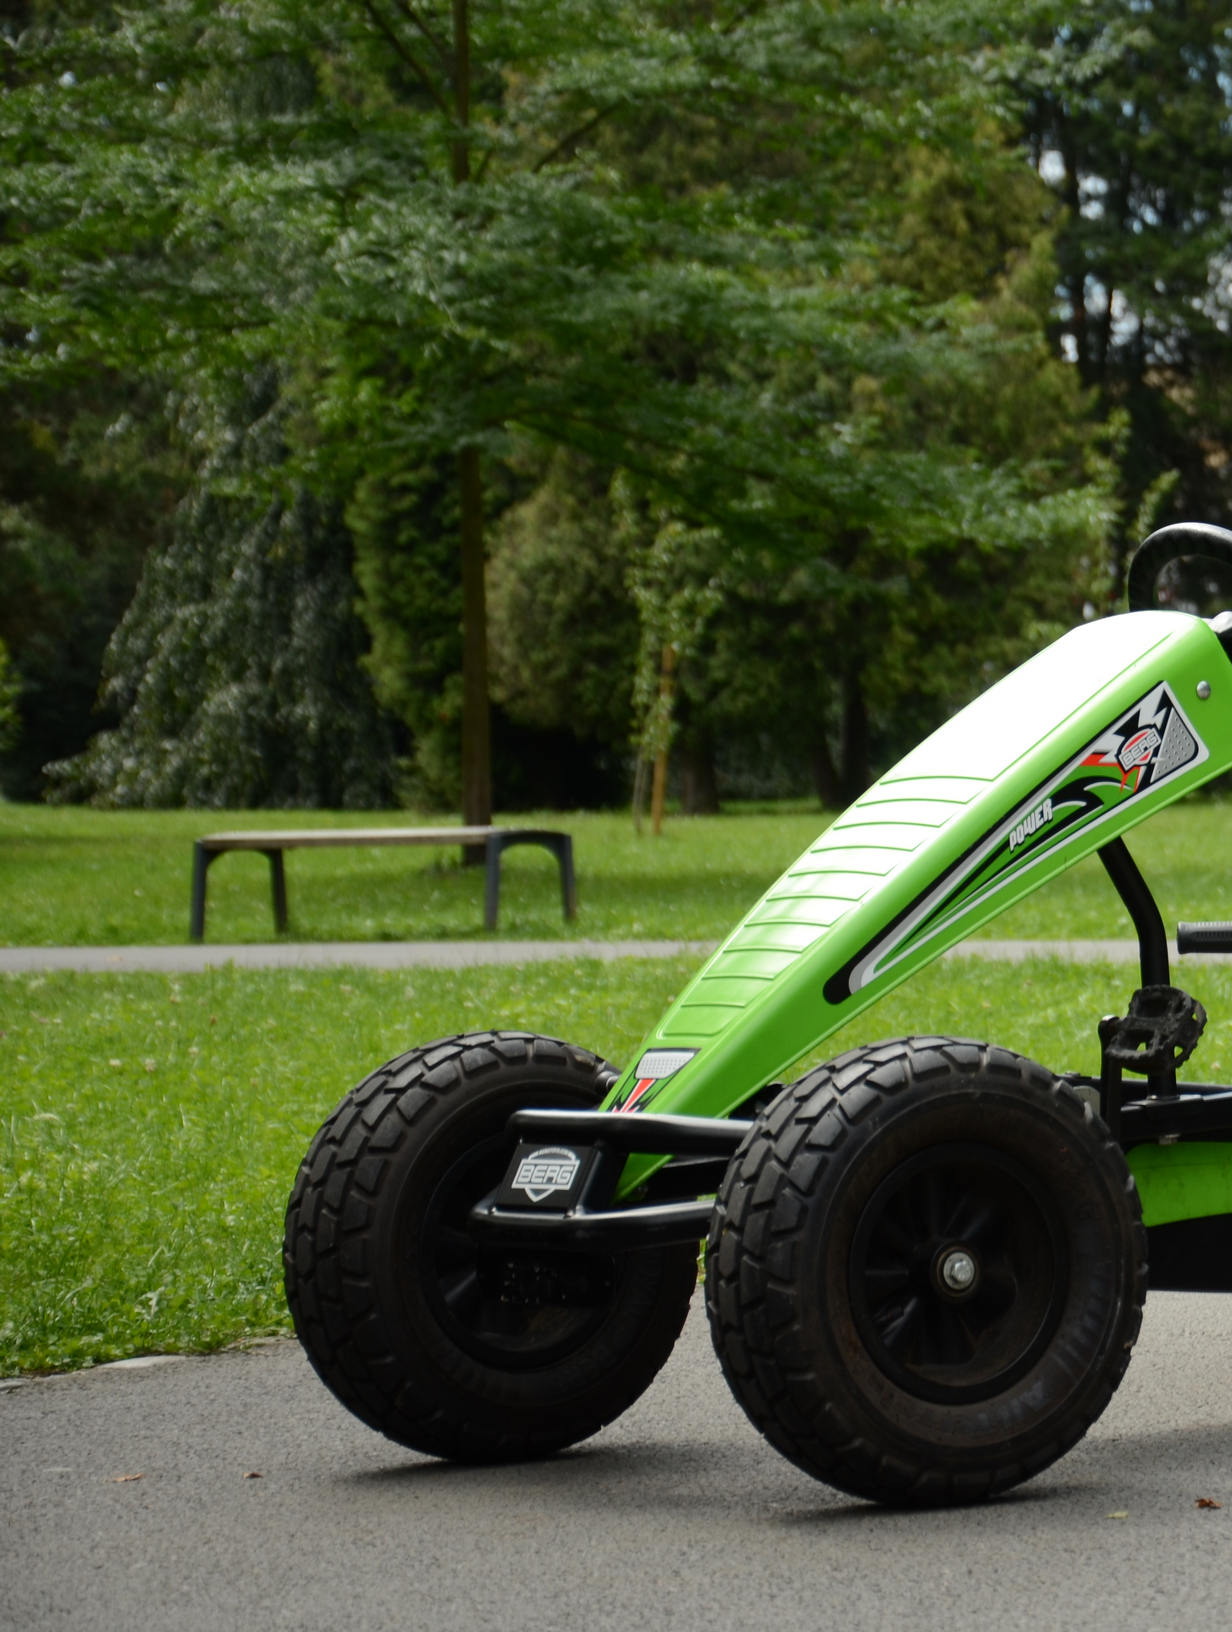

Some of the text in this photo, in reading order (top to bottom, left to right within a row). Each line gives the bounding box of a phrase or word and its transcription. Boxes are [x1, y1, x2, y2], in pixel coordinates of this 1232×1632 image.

[1122, 732, 1160, 765] BERG
[1009, 798, 1053, 852] POWER
[517, 1164, 574, 1185] BERG
